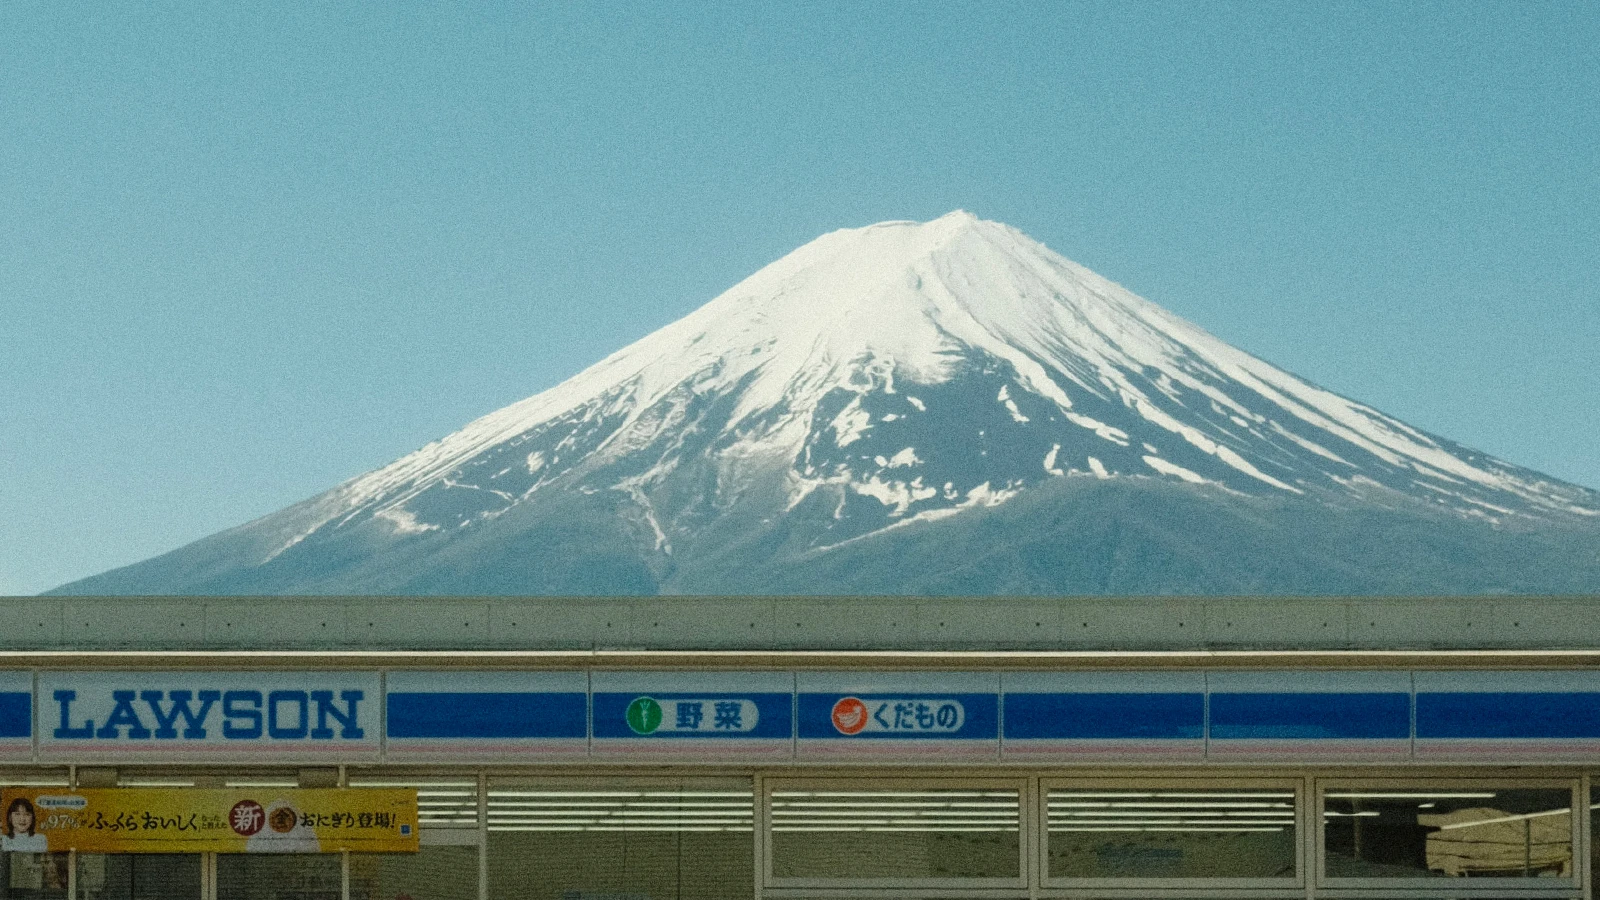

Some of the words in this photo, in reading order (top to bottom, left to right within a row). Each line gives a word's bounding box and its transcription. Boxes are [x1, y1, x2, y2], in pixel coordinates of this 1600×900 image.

[54, 690, 363, 738] LAWSON
[676, 702, 742, 730] 野菜
[873, 700, 957, 731] くだもの
[234, 805, 261, 831] 新
